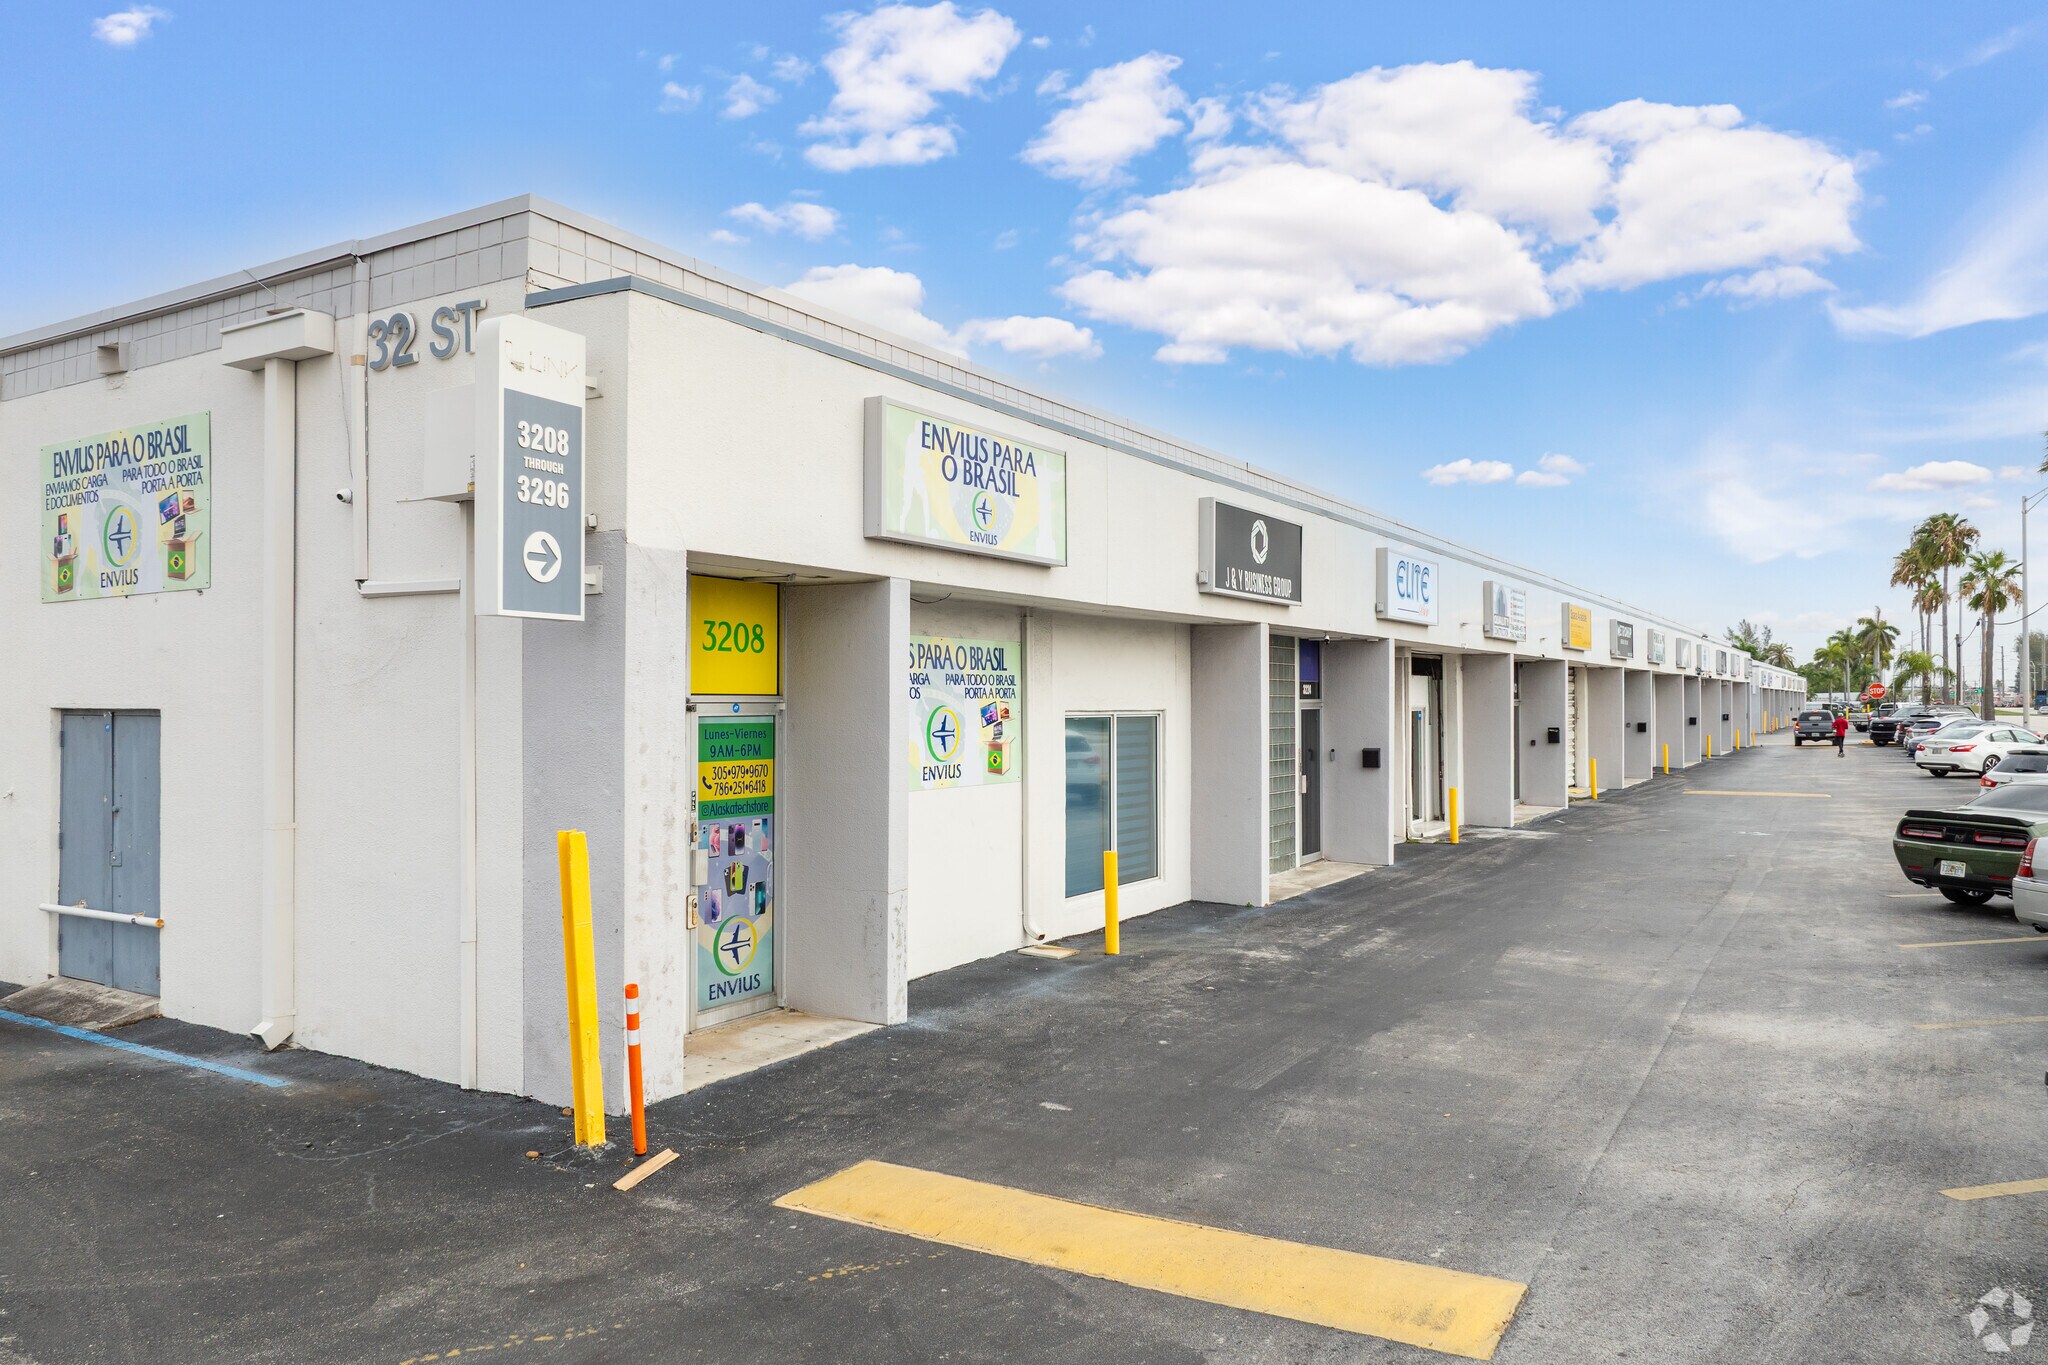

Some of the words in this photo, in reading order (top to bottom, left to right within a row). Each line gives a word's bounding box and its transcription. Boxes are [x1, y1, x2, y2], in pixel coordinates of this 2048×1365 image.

[368, 312, 419, 371] 32
[429, 298, 487, 359] ST
[517, 420, 569, 456] 3208
[921, 421, 989, 464] ENVIUS
[993, 441, 1037, 477] PARA
[53, 444, 94, 479] ENVIUS
[96, 437, 131, 471] PARA
[132, 434, 145, 463] O
[147, 424, 192, 460] BRASIL
[122, 466, 143, 483] PARA
[144, 461, 166, 478] TODO
[168, 460, 176, 474] O
[177, 454, 204, 471] BRASIL
[523, 456, 564, 475] THROUGH
[941, 455, 958, 482] O
[963, 459, 1020, 497] BRASIL
[45, 478, 81, 497] ENVIAMOS
[81, 473, 109, 489] CARGA
[141, 478, 166, 495] PORTA
[168, 477, 175, 490] A
[176, 471, 204, 489] PORTA
[517, 475, 569, 509] 3296
[45, 499, 51, 511] E
[50, 490, 99, 510] DOCUMENTOS
[969, 530, 998, 546] ENVIUS
[100, 568, 139, 589] ENVIUS
[1226, 567, 1231, 588] J
[1231, 567, 1238, 591] &
[1238, 569, 1244, 591] Y
[1244, 571, 1272, 595] BUSINESS
[1273, 577, 1292, 598] GROUP
[1396, 560, 1431, 603] ELITE
[702, 620, 766, 654] 3208
[917, 643, 954, 671] PARA
[955, 645, 968, 671] O
[969, 646, 1008, 672] BRASIL
[909, 672, 931, 686] ARGA
[945, 673, 965, 686] PARA
[965, 674, 988, 686] TODO
[988, 674, 995, 685] O
[995, 674, 1017, 687] BRASIL
[1869, 687, 1885, 695] STOP
[964, 687, 988, 700] PORTA
[987, 688, 994, 700] A
[995, 687, 1017, 700] PORTA
[704, 728, 767, 740] Lunes-Viernes
[922, 763, 962, 782] ENVIUS
[708, 973, 761, 1001] ENVIUS
